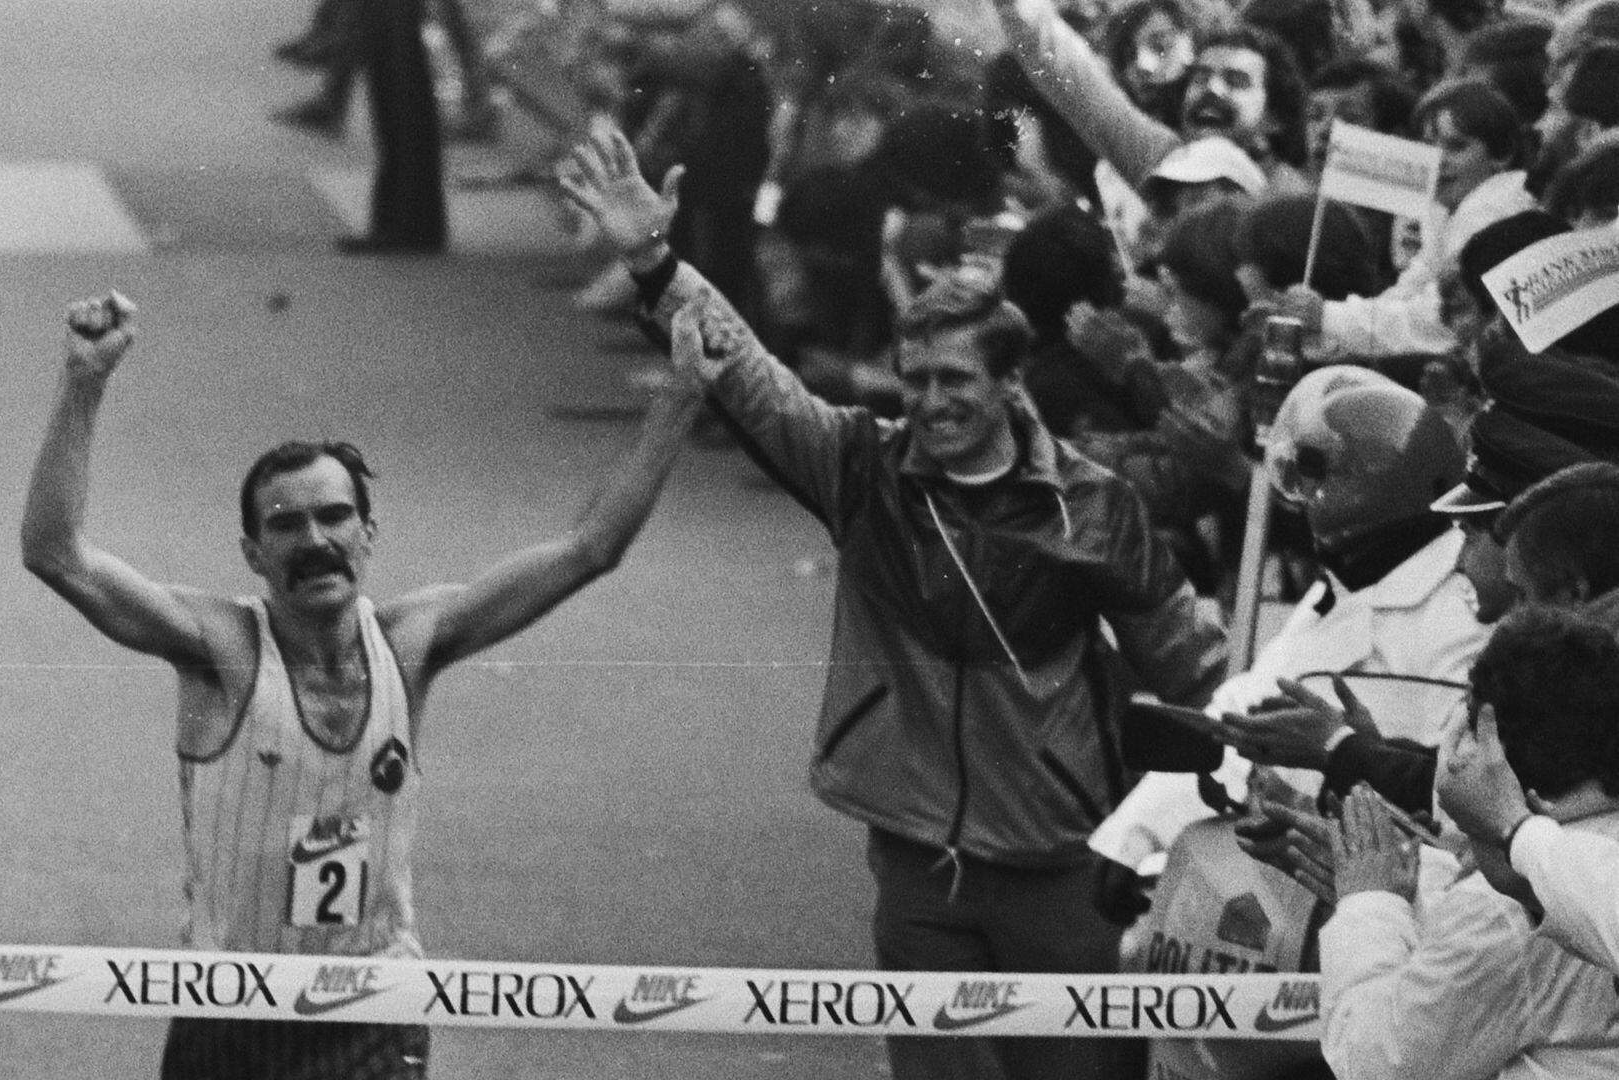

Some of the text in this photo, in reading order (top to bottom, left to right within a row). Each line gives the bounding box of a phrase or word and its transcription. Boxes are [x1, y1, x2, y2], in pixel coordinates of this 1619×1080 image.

[316, 861, 346, 923] 2
[103, 958, 278, 1009] XEROX
[311, 964, 383, 994] NIKE
[422, 970, 597, 1018] XEROX
[630, 974, 701, 1004] NIKE
[743, 979, 917, 1027] XEROX
[951, 980, 1022, 1009] NIKE
[1063, 985, 1238, 1031] XEROX
[1272, 981, 1321, 1011] NIK
